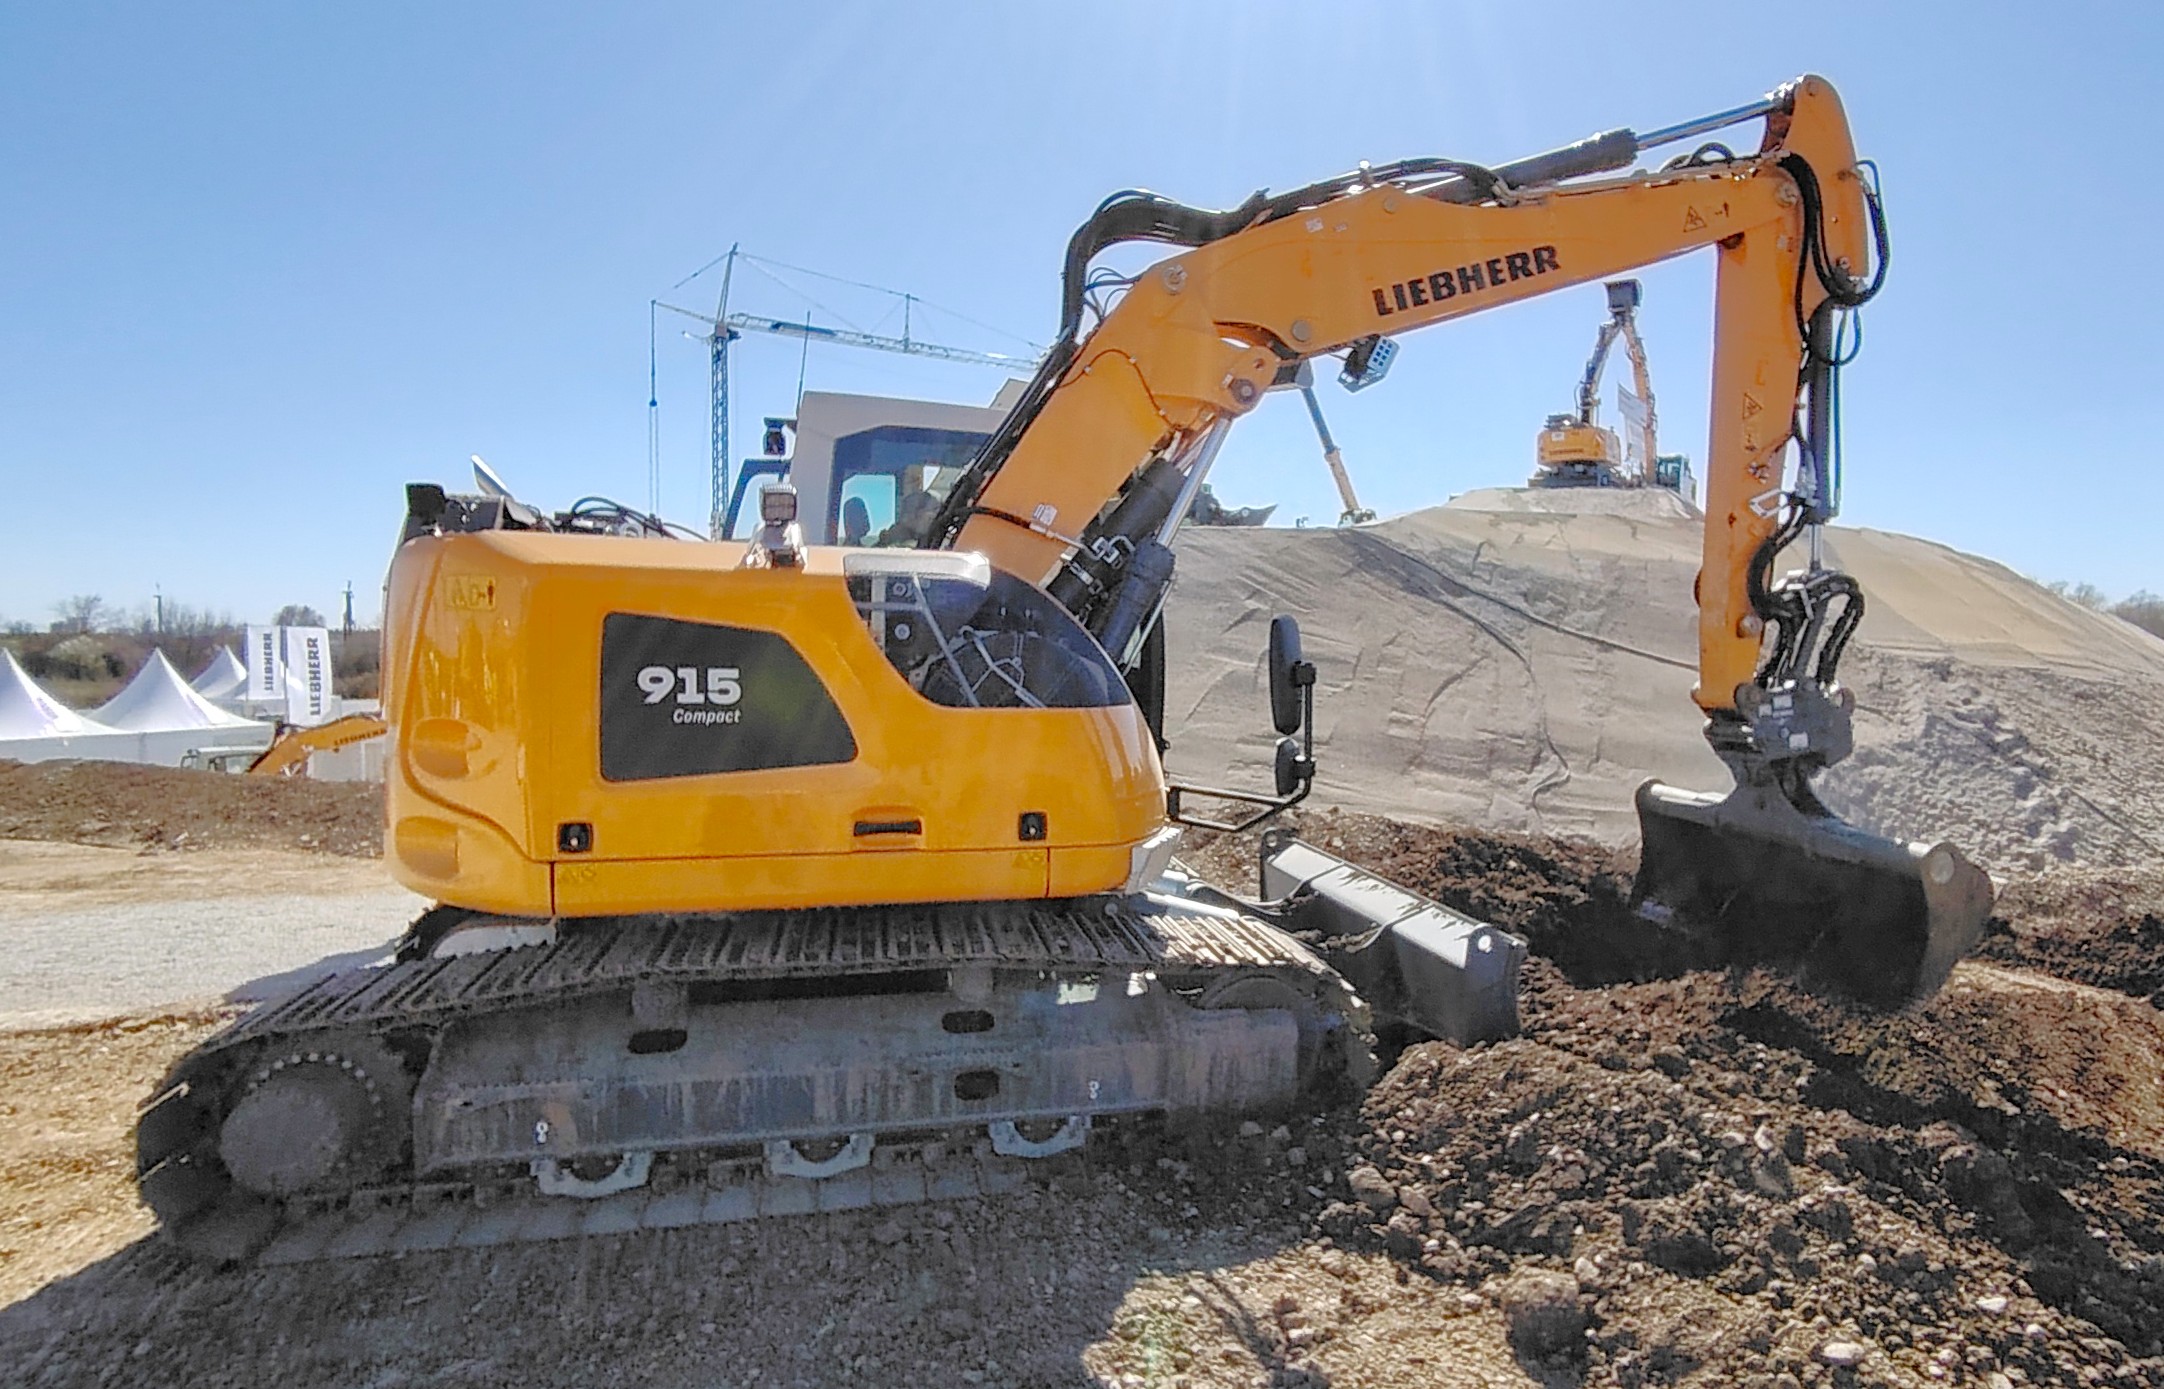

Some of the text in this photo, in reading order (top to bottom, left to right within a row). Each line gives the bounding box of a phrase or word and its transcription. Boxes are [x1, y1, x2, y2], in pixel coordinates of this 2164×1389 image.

[1372, 245, 1561, 316] LIEBHERR
[307, 637, 322, 716] LIEBHERR
[637, 665, 742, 705] 915
[673, 708, 741, 726] Compact
